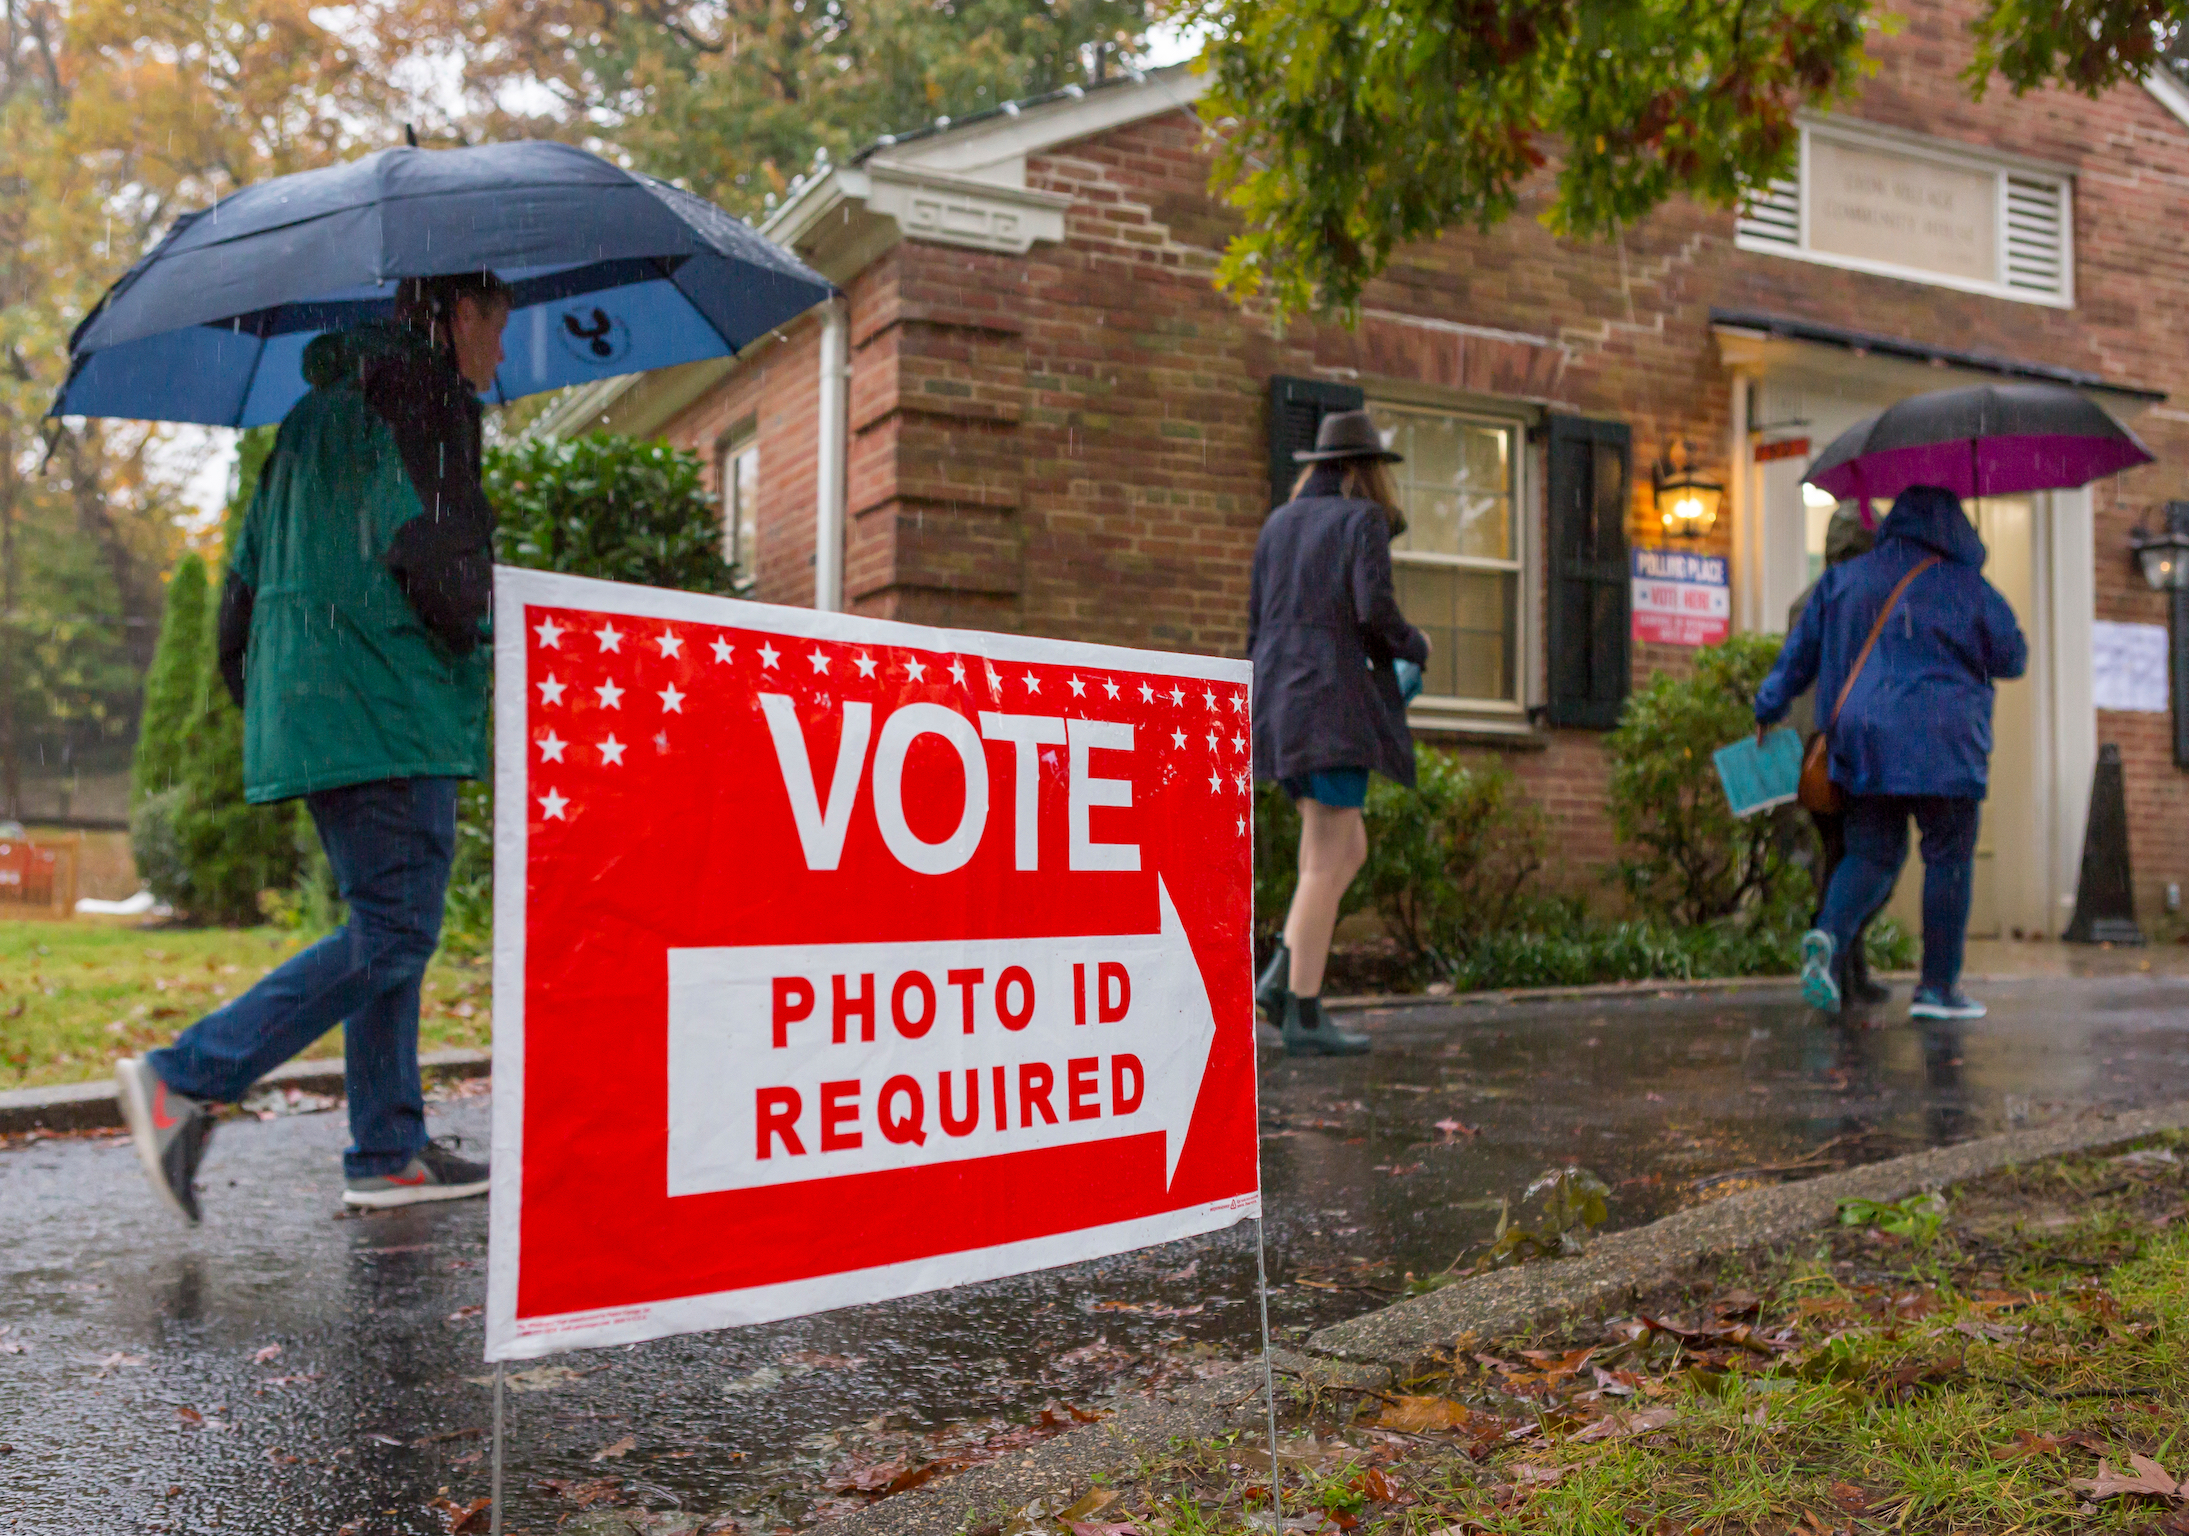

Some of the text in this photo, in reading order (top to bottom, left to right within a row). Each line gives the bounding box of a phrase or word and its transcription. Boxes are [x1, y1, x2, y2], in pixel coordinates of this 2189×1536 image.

[1638, 552, 1724, 584] POLLING PLACE
[1651, 587, 1710, 611] VOTE HERE
[758, 692, 1142, 876] VOTE
[771, 961, 1131, 1049] PHOTO ID
[755, 1053, 1145, 1161] REQUIRED
